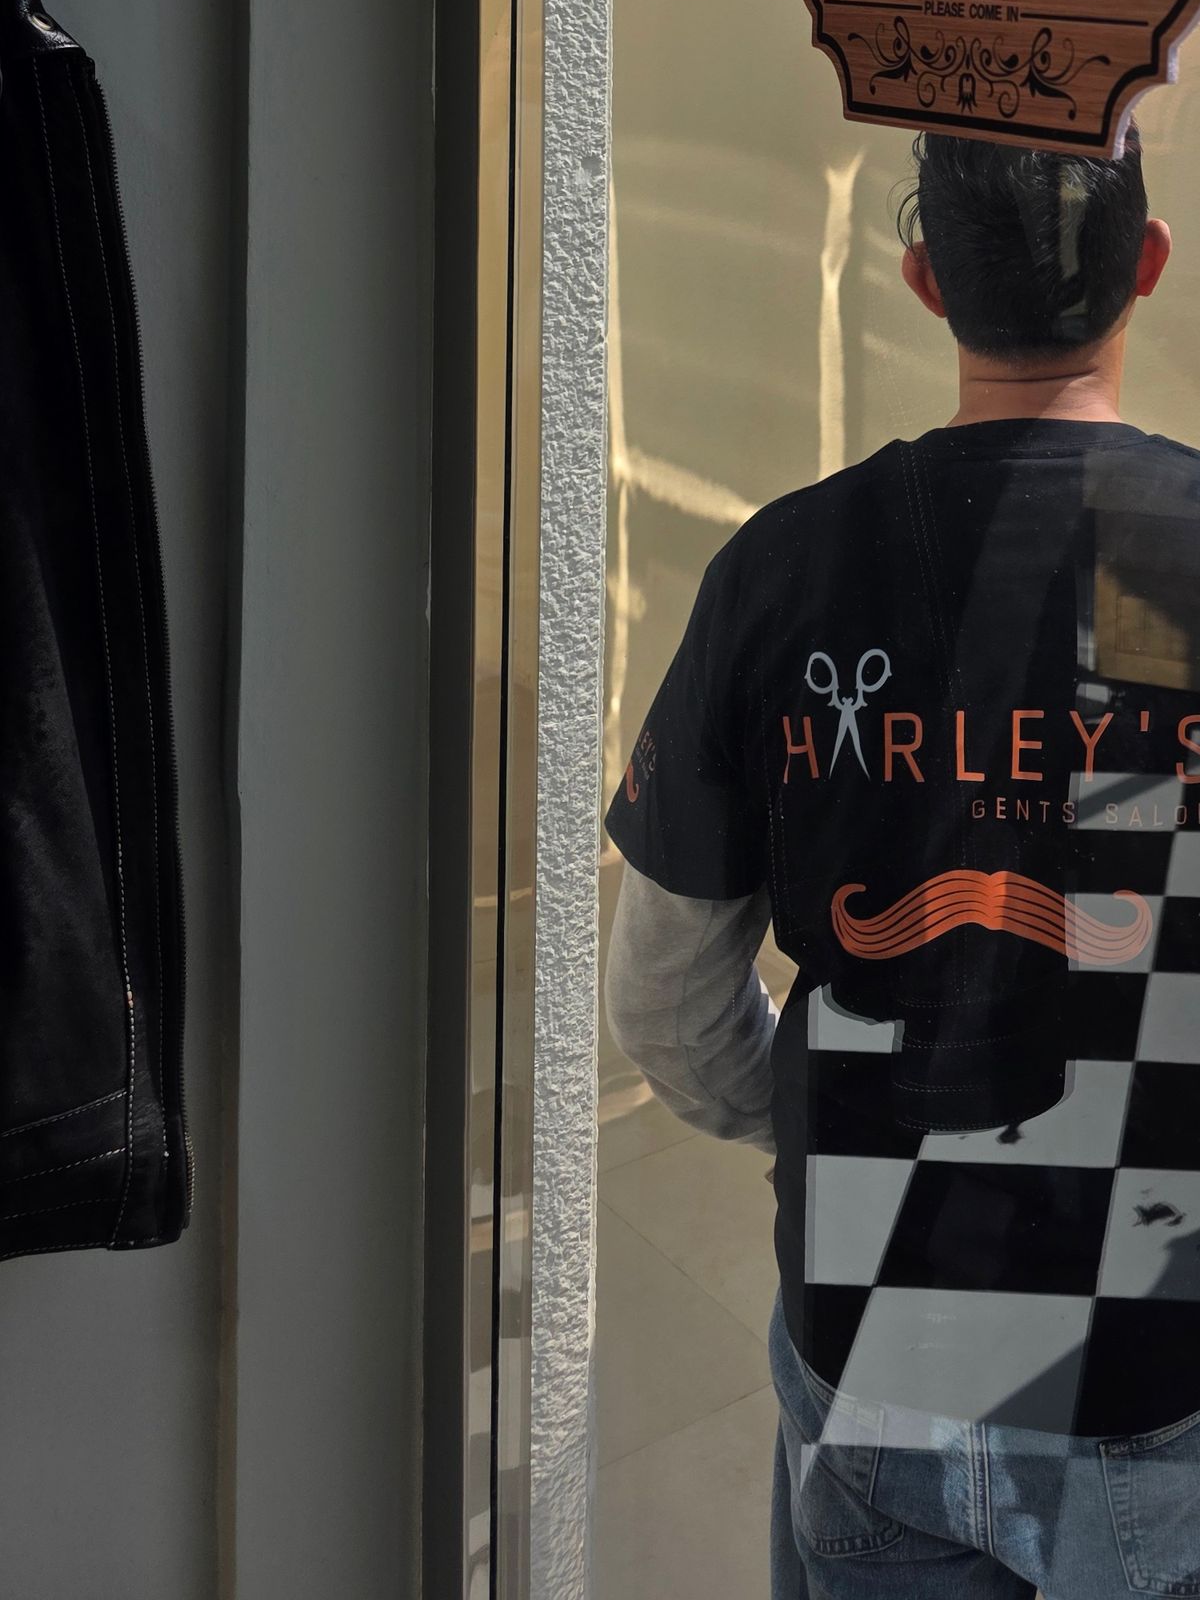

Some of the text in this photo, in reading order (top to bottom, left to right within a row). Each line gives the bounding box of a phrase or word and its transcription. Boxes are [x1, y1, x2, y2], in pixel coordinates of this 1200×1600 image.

[923, 1, 1019, 22] PLEASE COME IN
[971, 796, 1078, 825] GENTS
